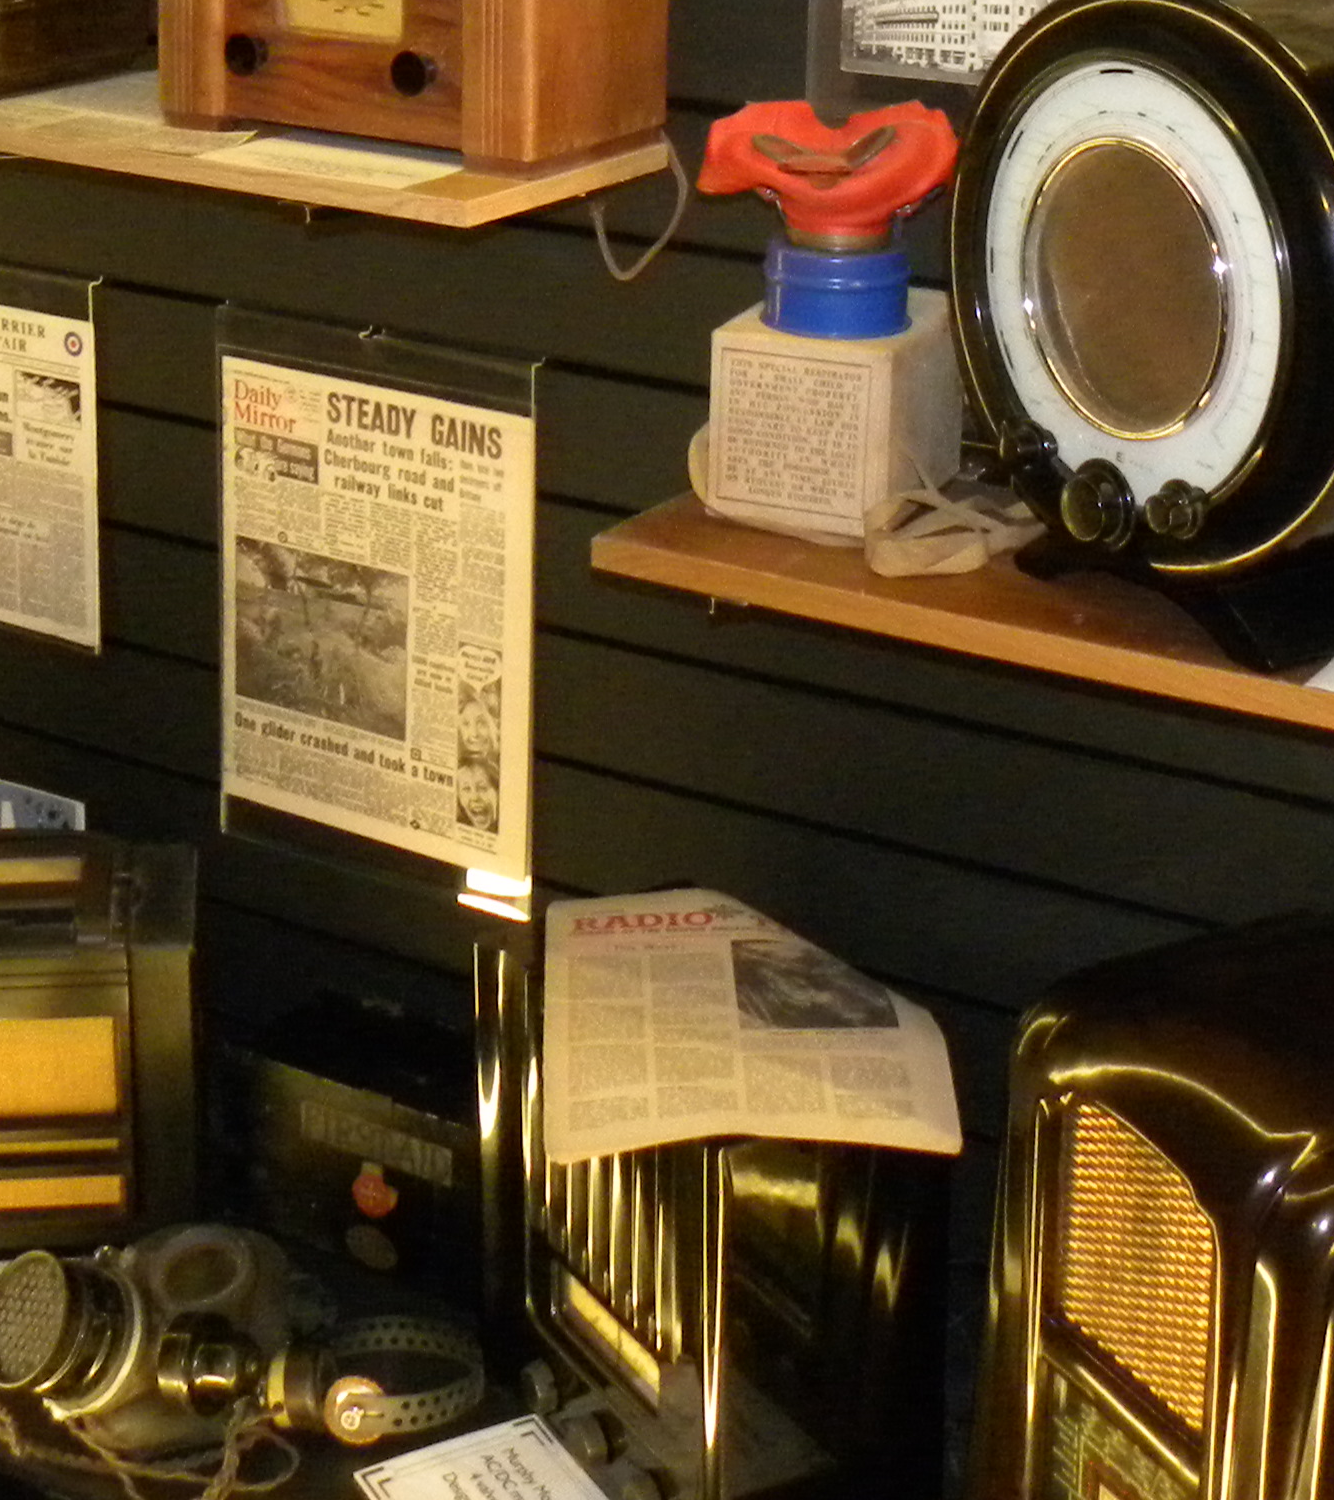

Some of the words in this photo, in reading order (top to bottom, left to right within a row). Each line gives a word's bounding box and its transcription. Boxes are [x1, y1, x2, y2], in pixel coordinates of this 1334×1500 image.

[234, 379, 282, 410] Daily
[234, 402, 297, 434] Mirror
[327, 391, 417, 439] STEADY
[431, 413, 503, 460] GAINS
[327, 429, 375, 453] Another
[382, 440, 414, 460] town
[420, 447, 453, 471] falls:
[324, 449, 391, 480] Cherbourg
[398, 466, 426, 486] road
[432, 474, 455, 493] and
[334, 473, 381, 499] railway
[387, 483, 418, 506] links
[423, 492, 444, 512] cut
[234, 712, 257, 732] One
[261, 720, 296, 742] glider
[300, 733, 348, 757] crashed
[353, 747, 374, 765] and
[379, 753, 406, 773] took
[411, 763, 419, 778] a
[423, 765, 453, 787] town
[573, 911, 714, 933] RADIO
[502, 1446, 535, 1484] Murphy
